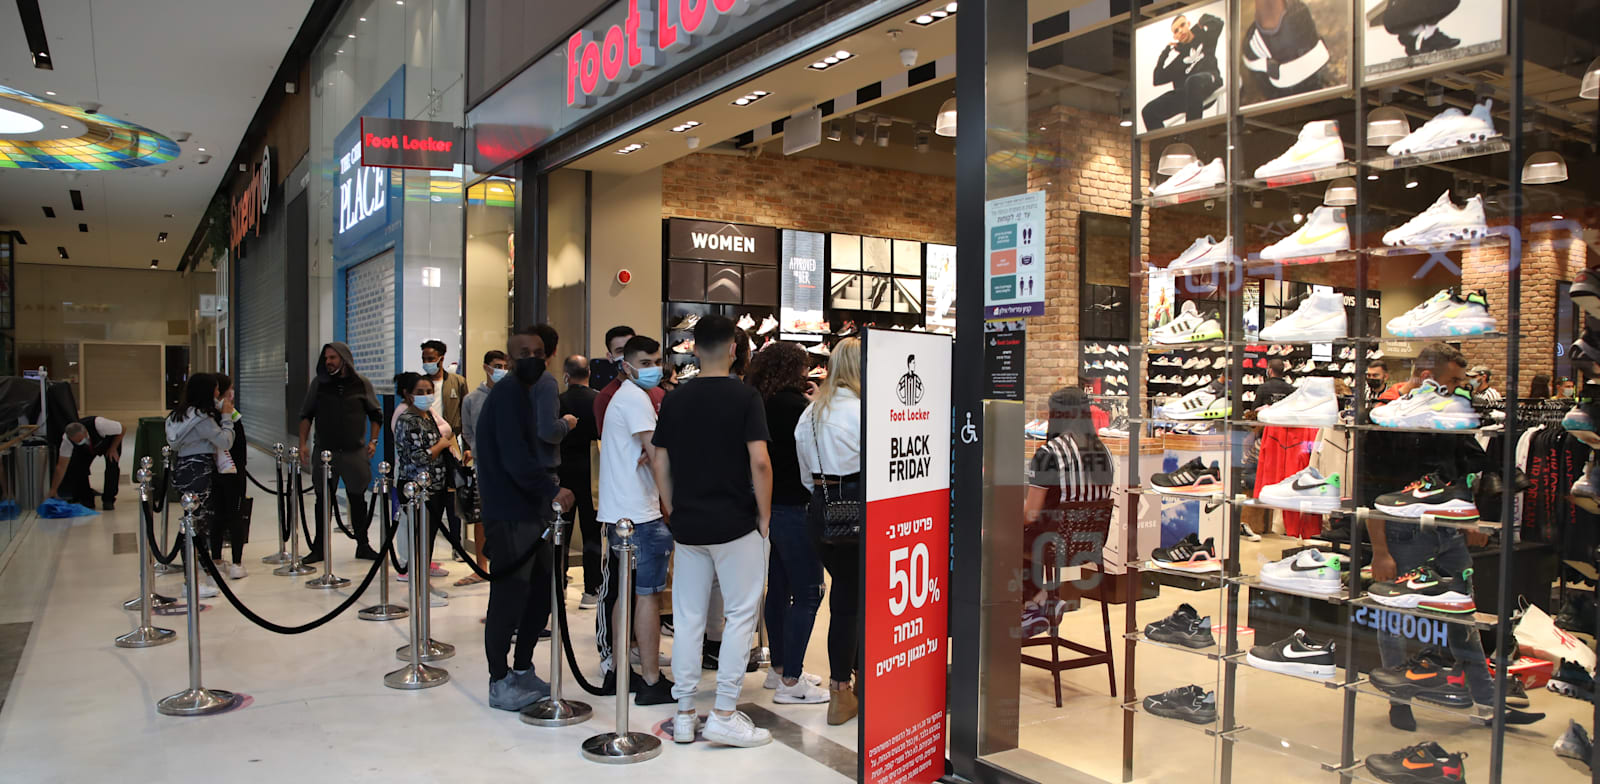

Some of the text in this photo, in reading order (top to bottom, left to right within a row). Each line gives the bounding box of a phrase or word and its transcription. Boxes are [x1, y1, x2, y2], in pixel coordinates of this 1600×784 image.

[567, 0, 642, 105] Foot
[365, 133, 453, 152] Foot Locker
[339, 165, 385, 234] PLACE
[691, 232, 755, 253] WOMEN
[789, 257, 817, 271] APPROVED
[1343, 295, 1356, 307] OYS
[890, 408, 930, 421] Foot Locker
[891, 434, 930, 459] BLACK
[889, 456, 931, 482] FRIDAY
[897, 521, 912, 537] שני
[912, 517, 933, 533] פריט
[1122, 520, 1157, 530] CVERSE
[888, 543, 940, 616] 50%
[893, 617, 923, 645] הנחה
[876, 638, 938, 677] על מגוון פריטים
